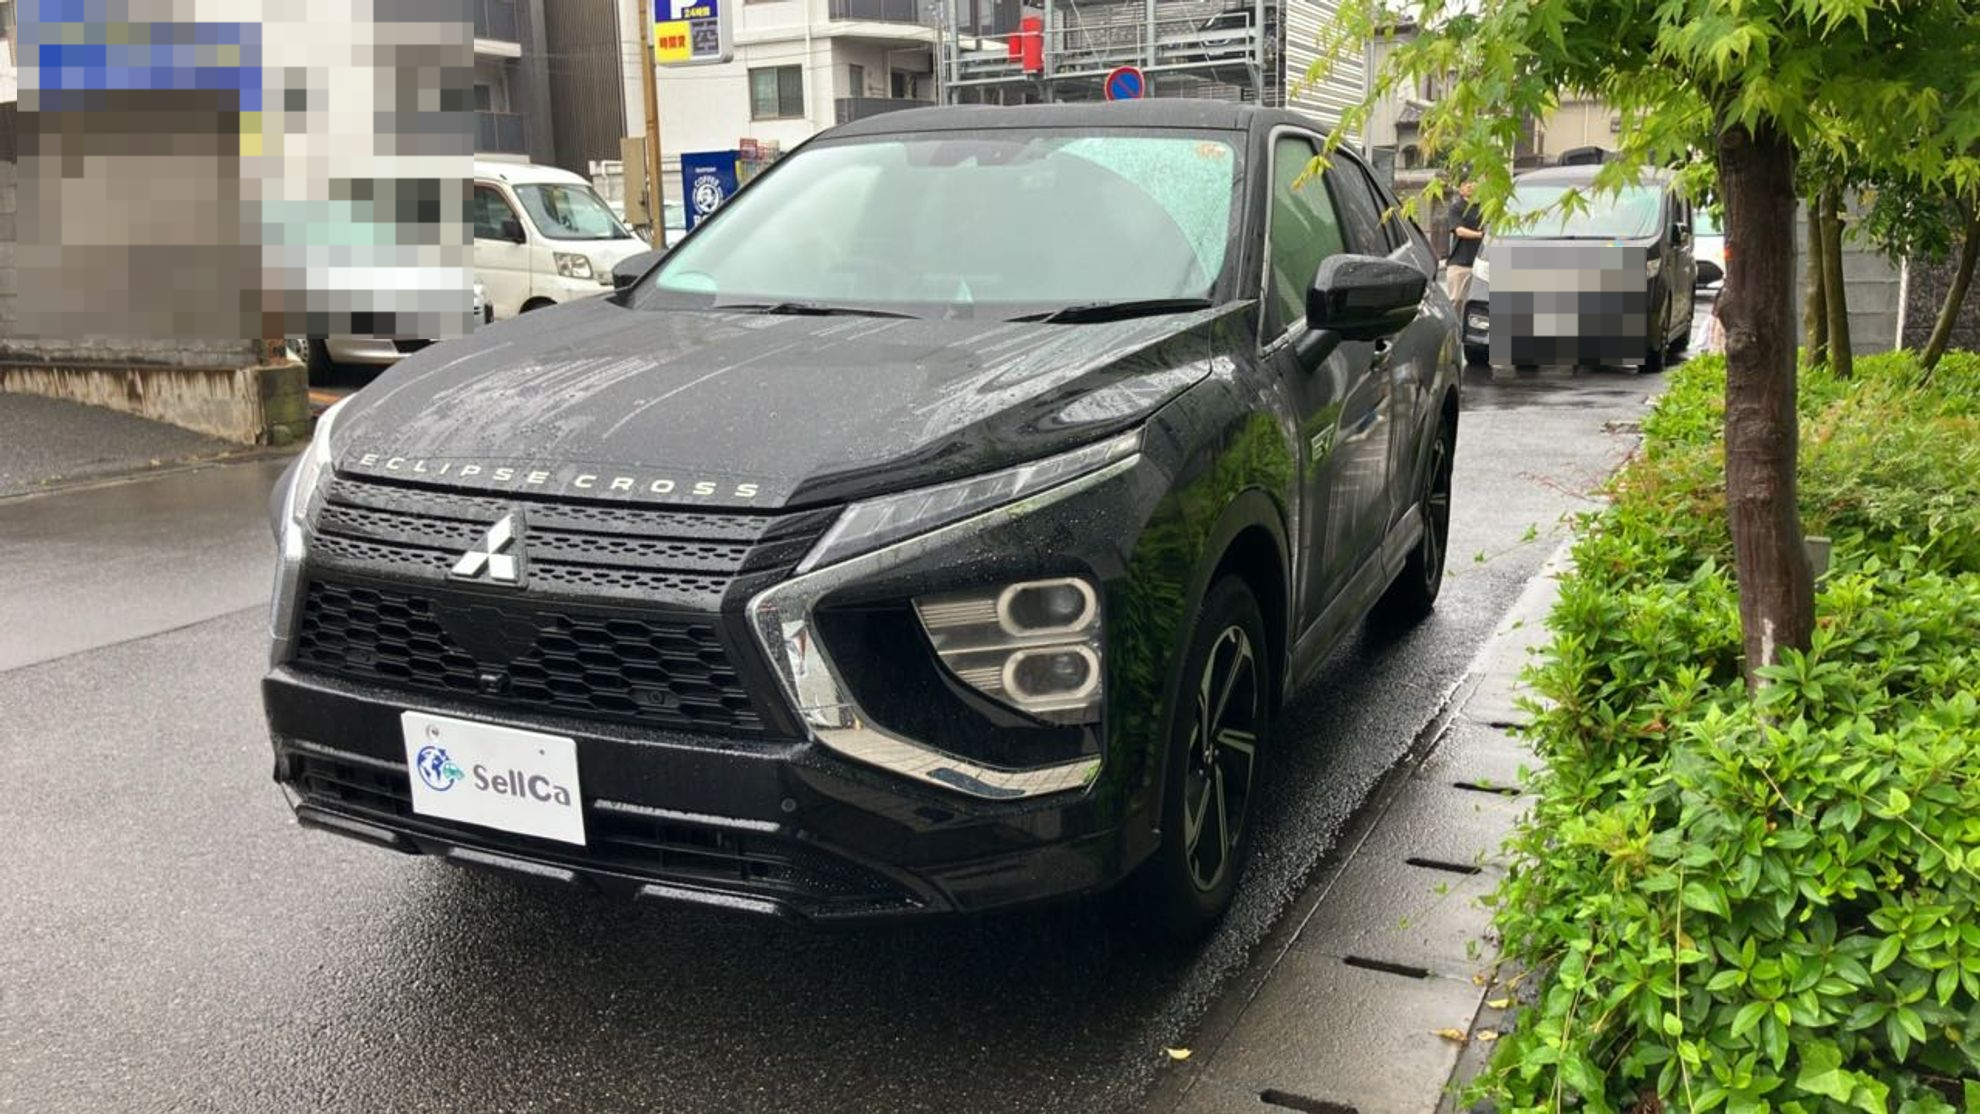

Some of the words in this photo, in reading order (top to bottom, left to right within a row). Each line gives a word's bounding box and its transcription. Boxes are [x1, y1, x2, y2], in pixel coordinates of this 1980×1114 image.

[360, 452, 549, 484] ECLIPSE
[574, 474, 760, 499] CROSS
[473, 764, 571, 806] SellCa
